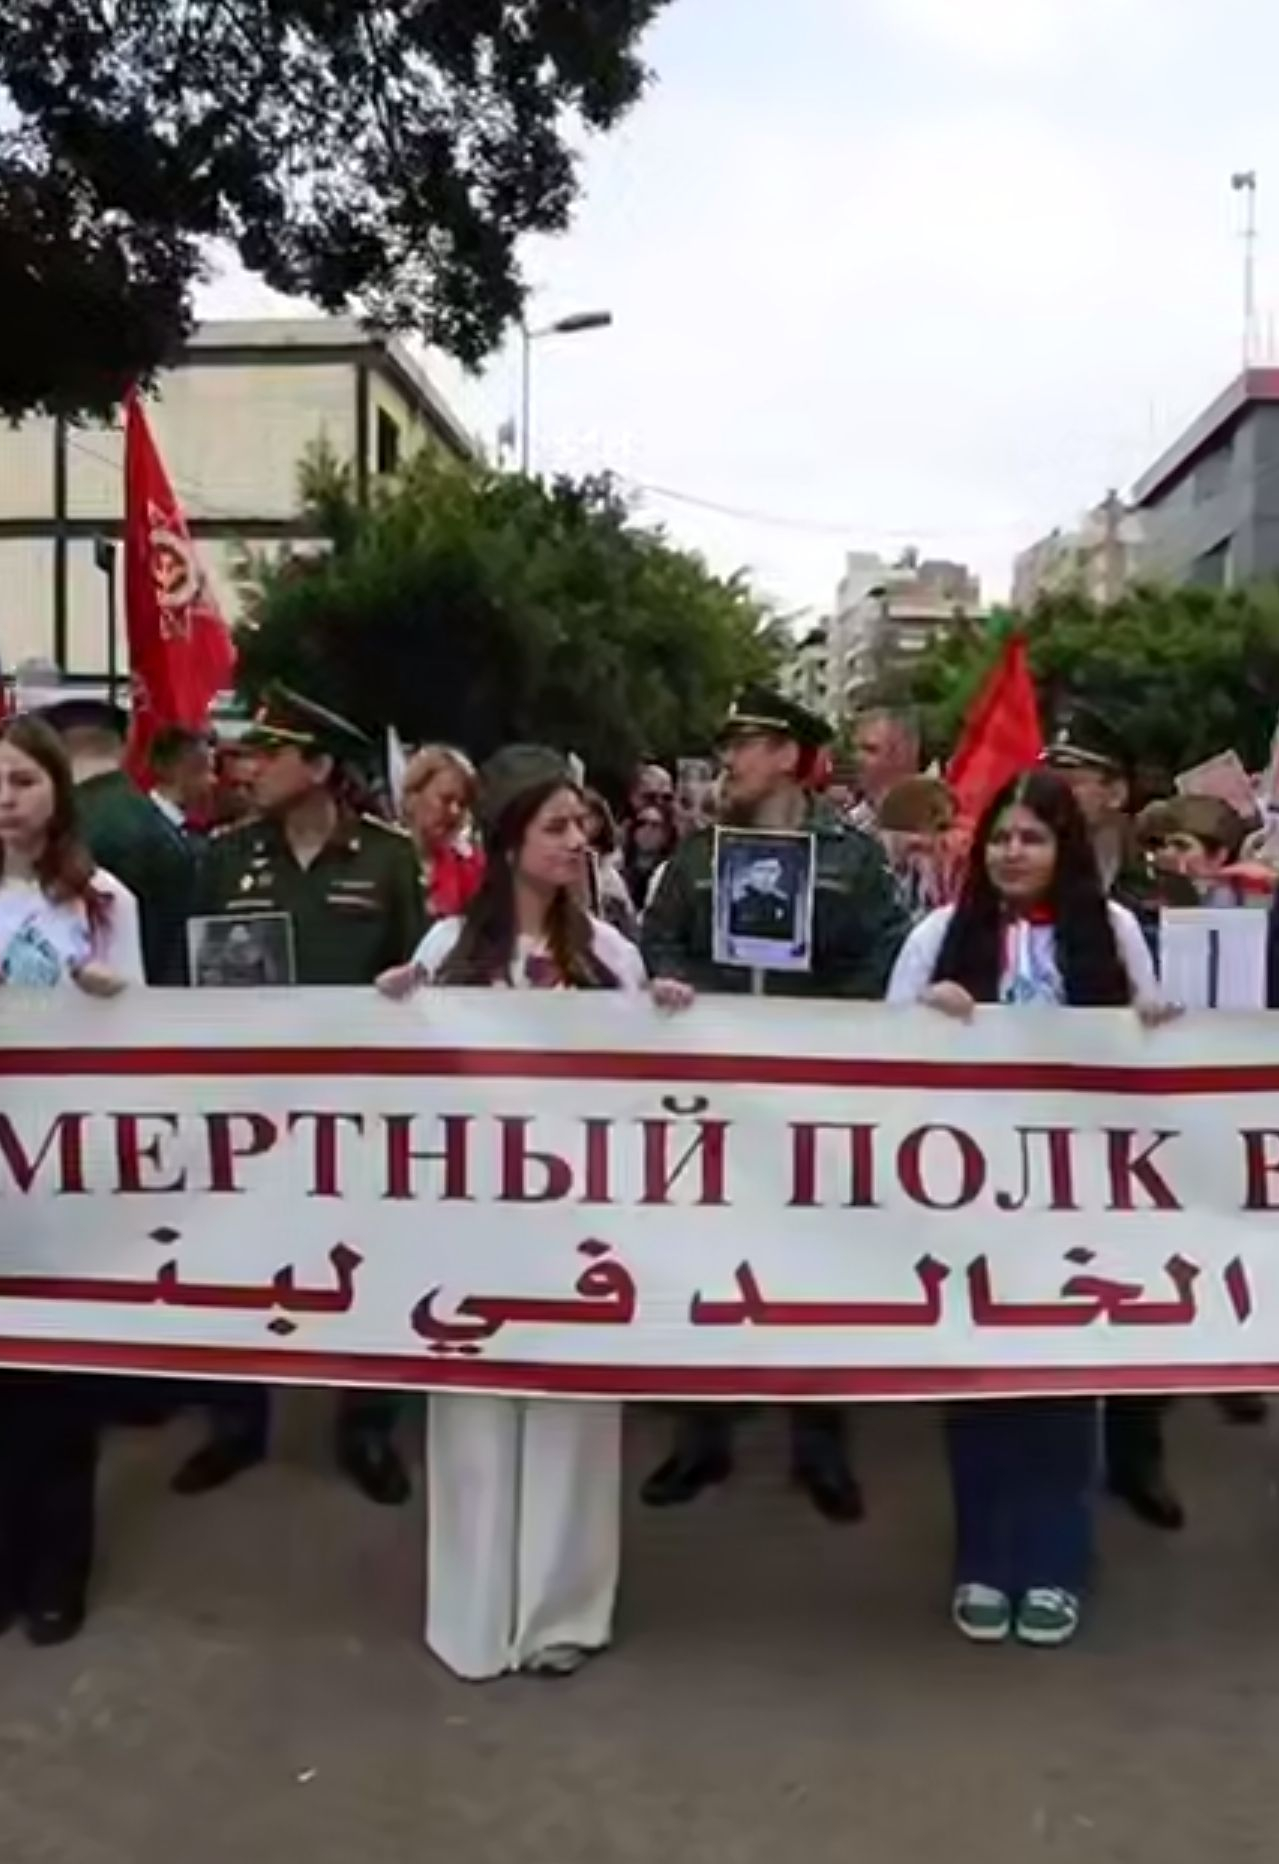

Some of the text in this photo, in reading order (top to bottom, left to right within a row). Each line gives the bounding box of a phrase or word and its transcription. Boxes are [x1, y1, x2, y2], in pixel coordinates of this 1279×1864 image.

[786, 1121, 1183, 1211] ПОЛК
[410, 1238, 637, 1355] في
[689, 1247, 1251, 1328] الخالد
